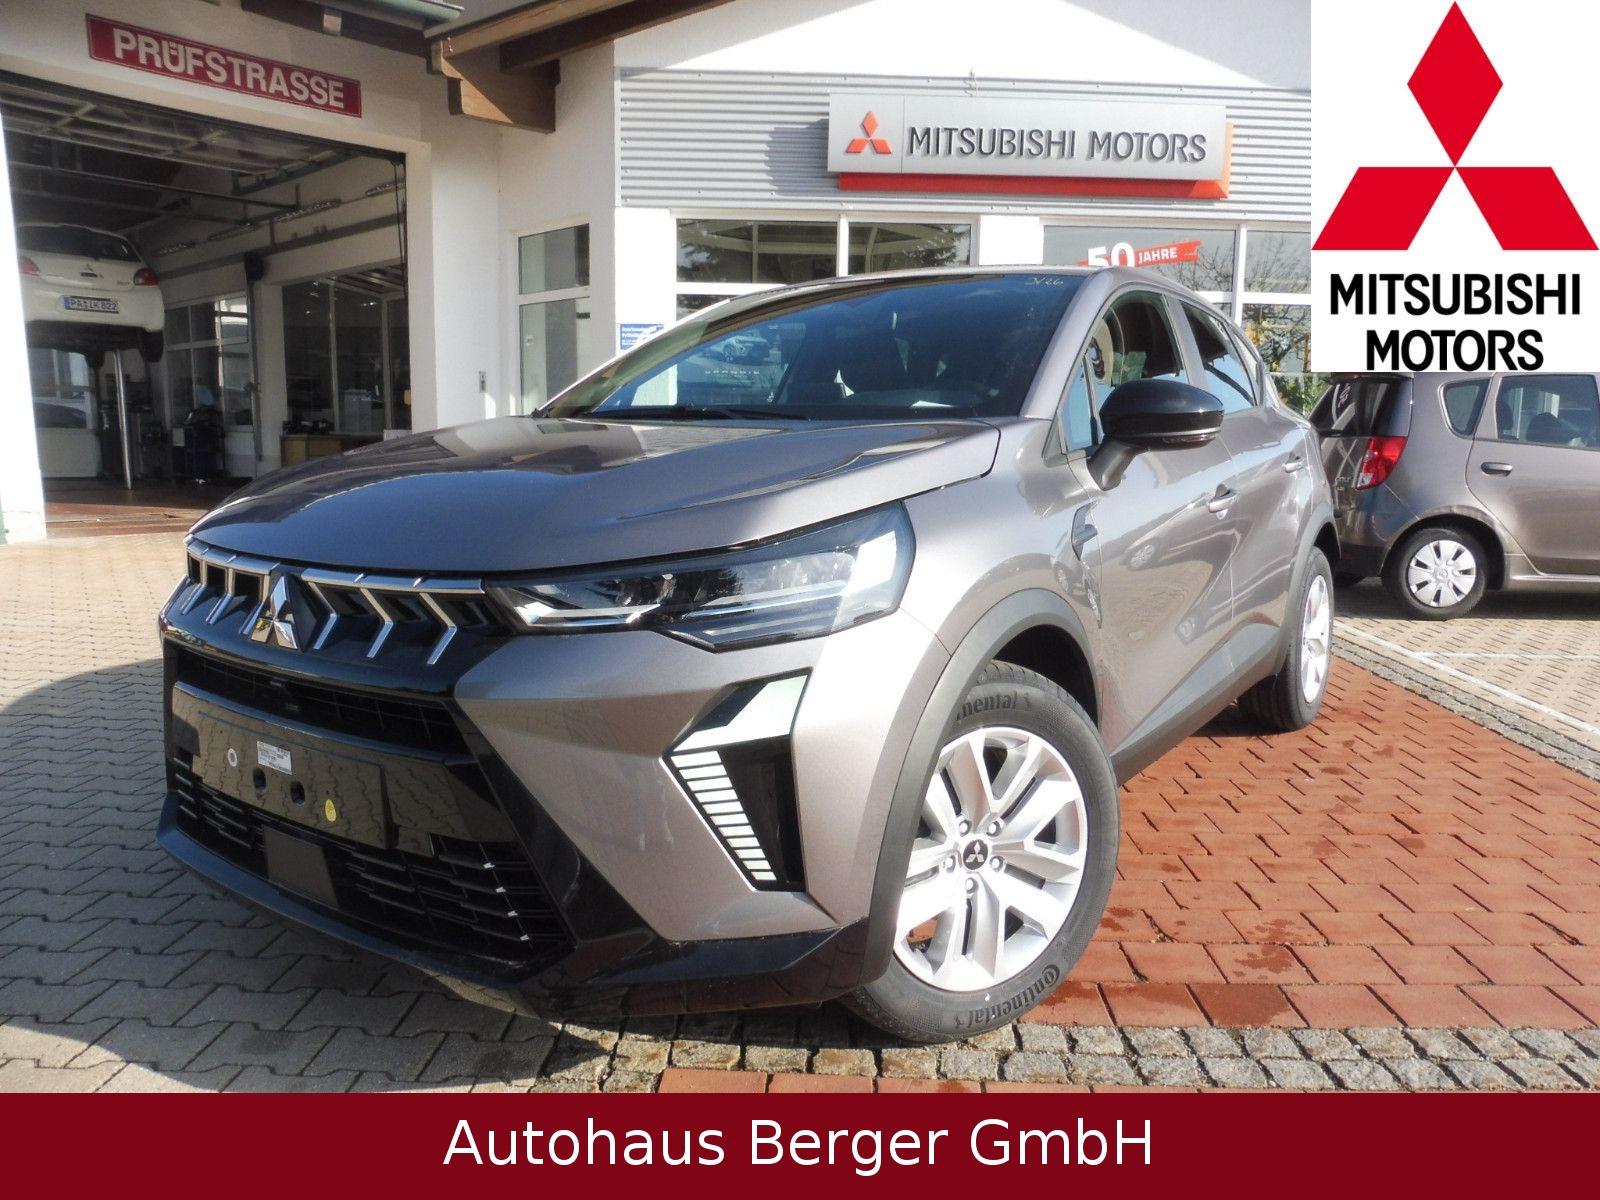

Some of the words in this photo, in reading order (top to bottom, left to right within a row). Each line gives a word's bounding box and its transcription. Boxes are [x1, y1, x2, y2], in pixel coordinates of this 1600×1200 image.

[112, 28, 345, 109] PRÜFSTRASSE
[908, 126, 1076, 158] MITSUBISHI
[1089, 130, 1207, 162] MOTORS
[1138, 246, 1178, 264] JAHRE
[967, 964, 1061, 1029] Continental
